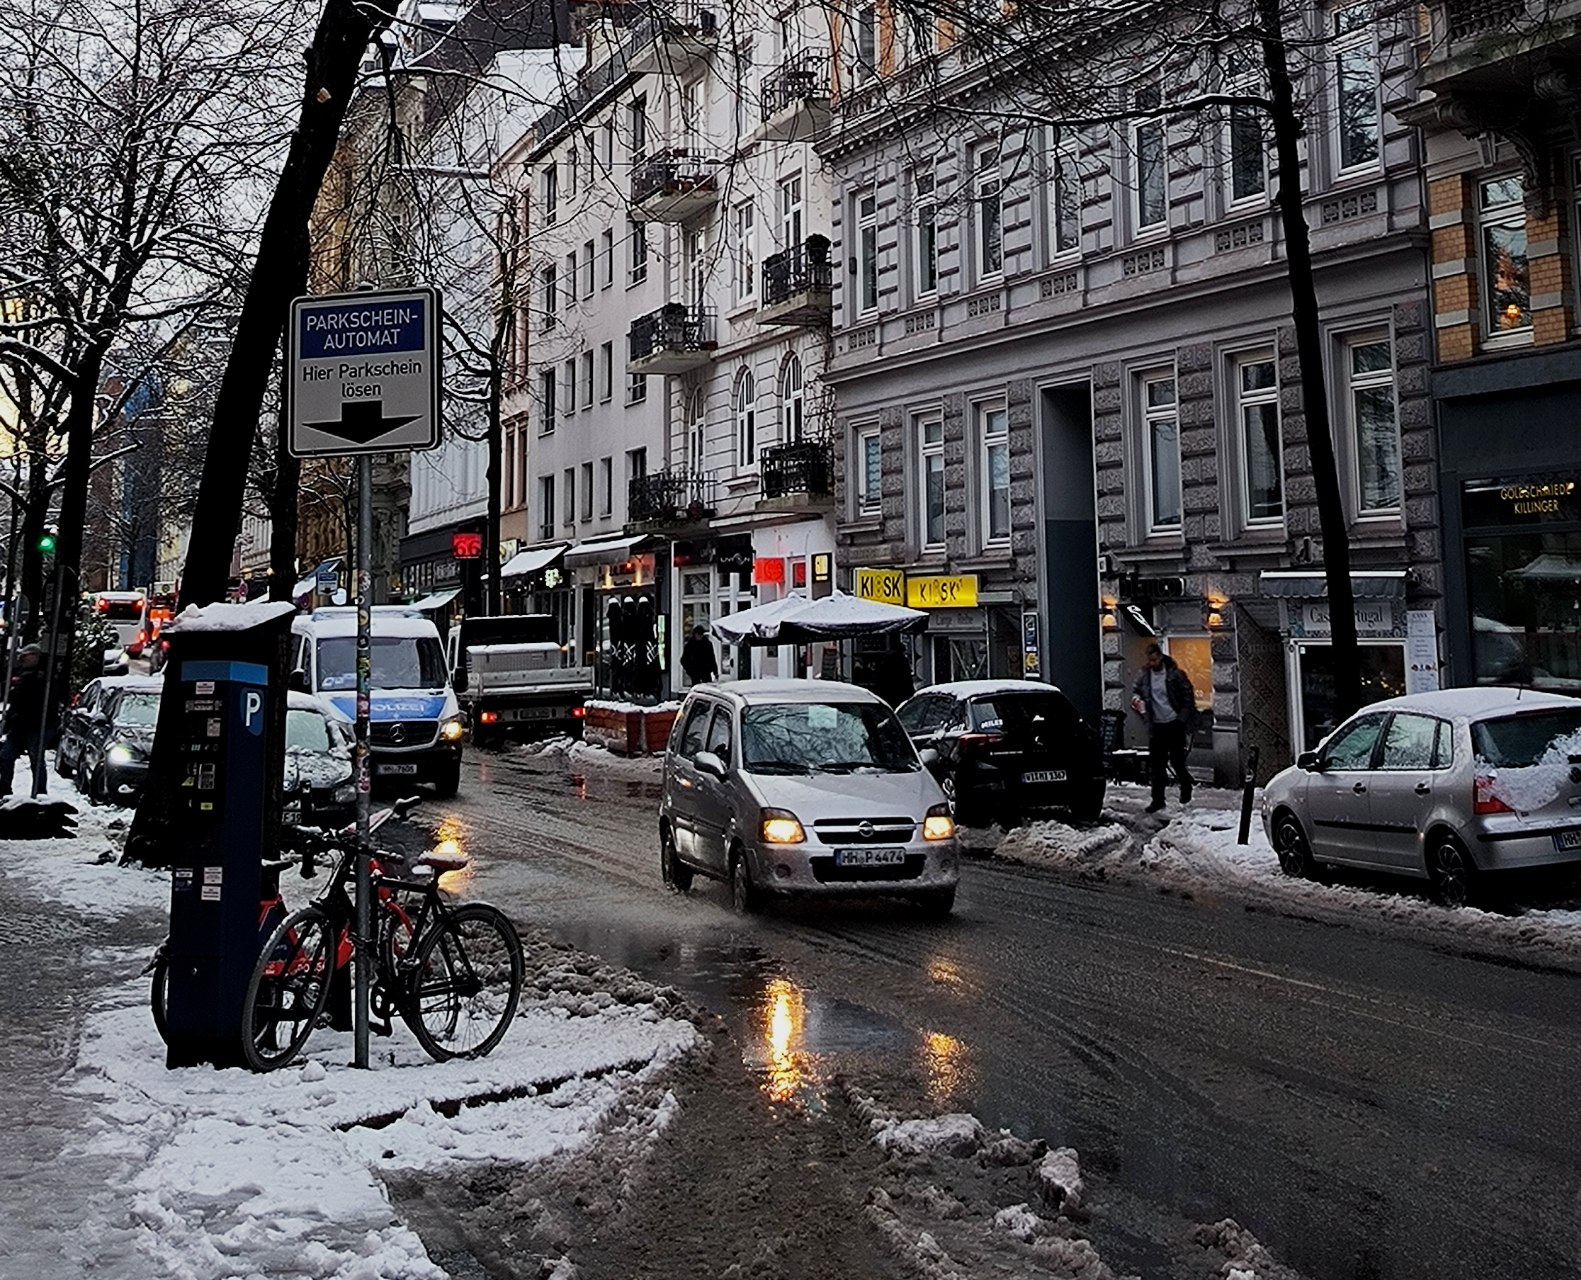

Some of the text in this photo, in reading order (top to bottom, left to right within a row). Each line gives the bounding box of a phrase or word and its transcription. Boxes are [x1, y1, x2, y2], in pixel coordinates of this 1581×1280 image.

[306, 307, 418, 331] PARKSCHEIN-
[323, 328, 401, 350] AUTOMAT
[302, 359, 423, 382] Hier Parkschein
[341, 382, 381, 398] lösen
[1514, 499, 1559, 514] KILLINGER
[1310, 607, 1331, 623] Cas
[245, 692, 261, 727] P
